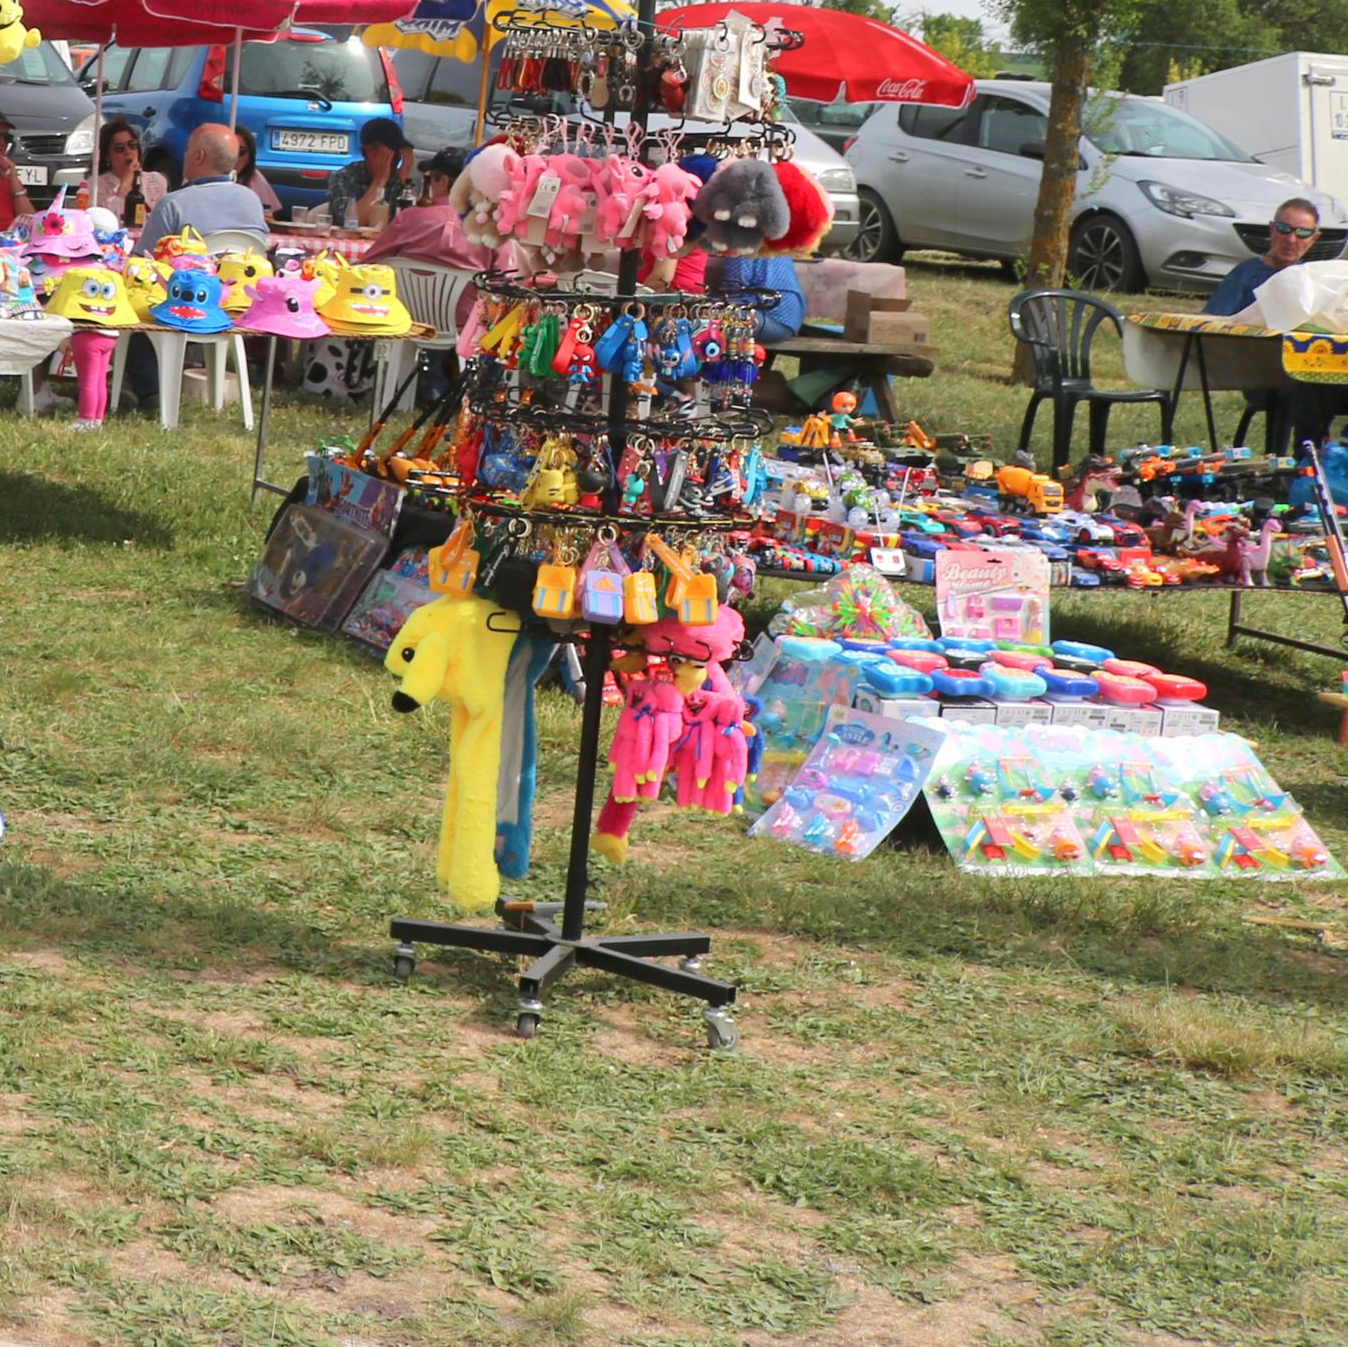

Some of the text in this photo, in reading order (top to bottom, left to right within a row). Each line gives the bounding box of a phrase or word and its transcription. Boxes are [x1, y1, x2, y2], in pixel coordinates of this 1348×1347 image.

[281, 133, 346, 149] 4972 FPD
[942, 562, 1007, 586] Beauty
